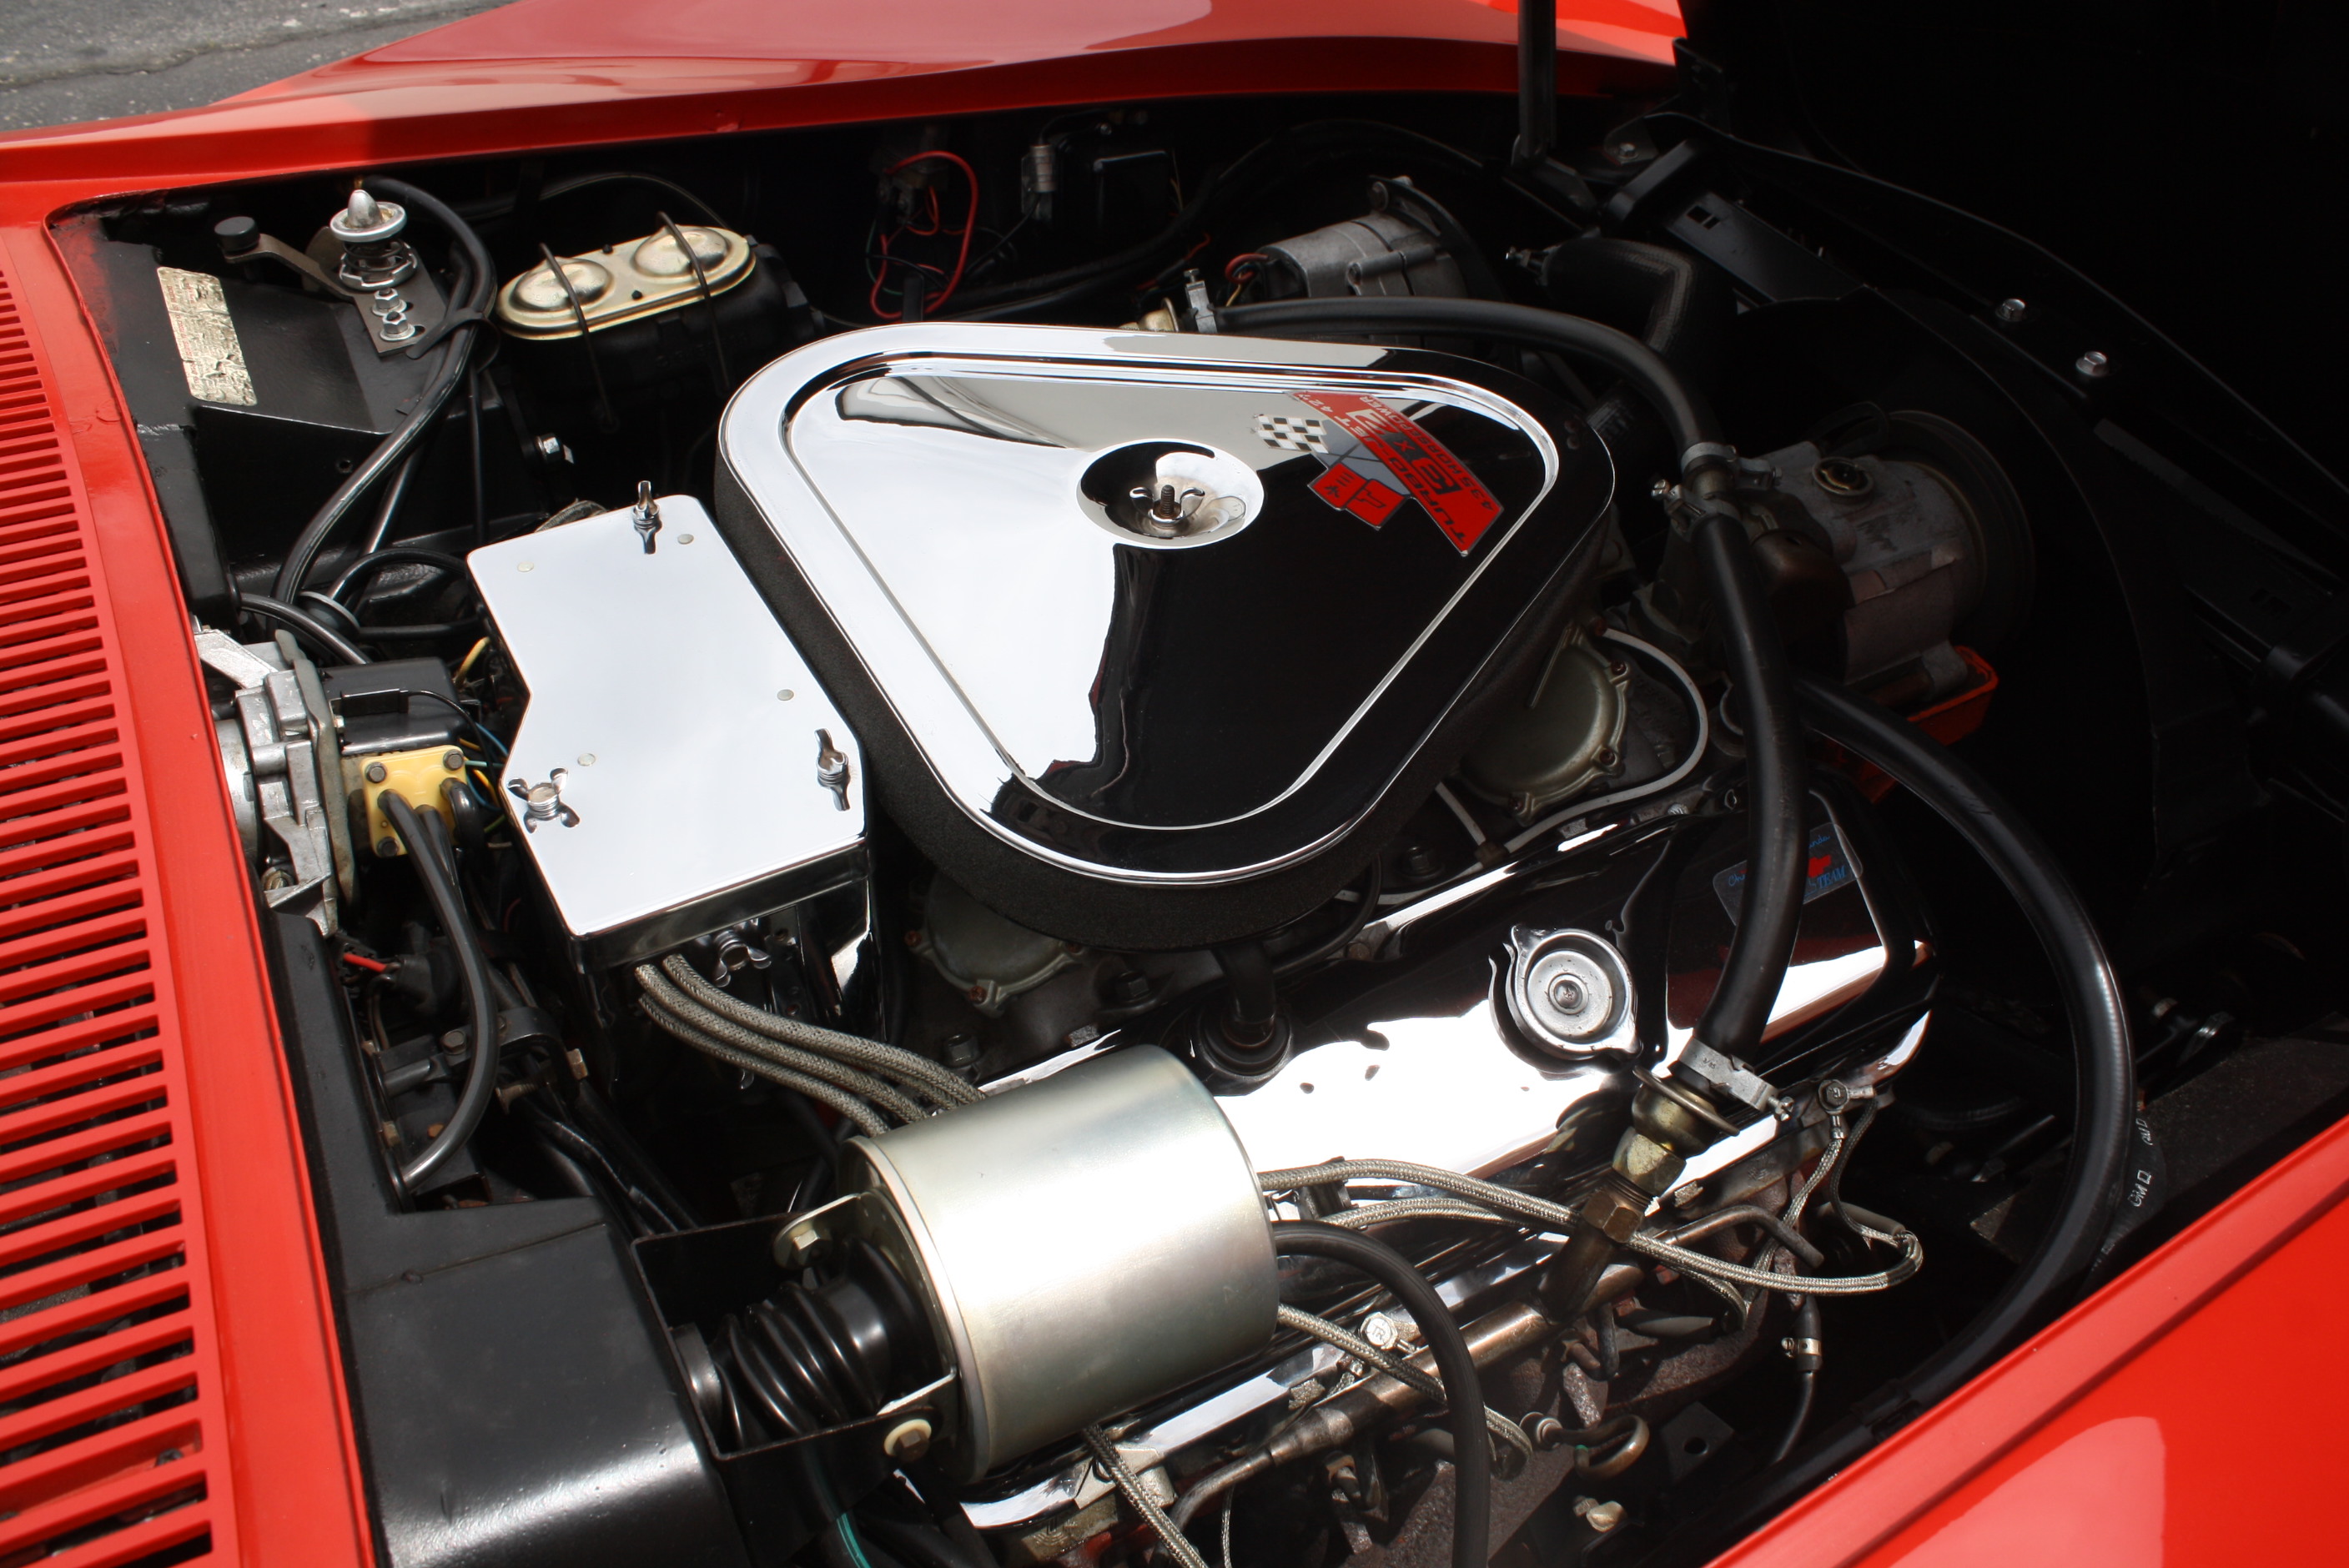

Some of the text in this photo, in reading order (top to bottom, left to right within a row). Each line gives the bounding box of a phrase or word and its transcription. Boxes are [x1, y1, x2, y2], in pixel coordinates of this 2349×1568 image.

[1334, 415, 1466, 544] TURBO-JET
[1360, 395, 1494, 510] 435 HORSEPOWER
